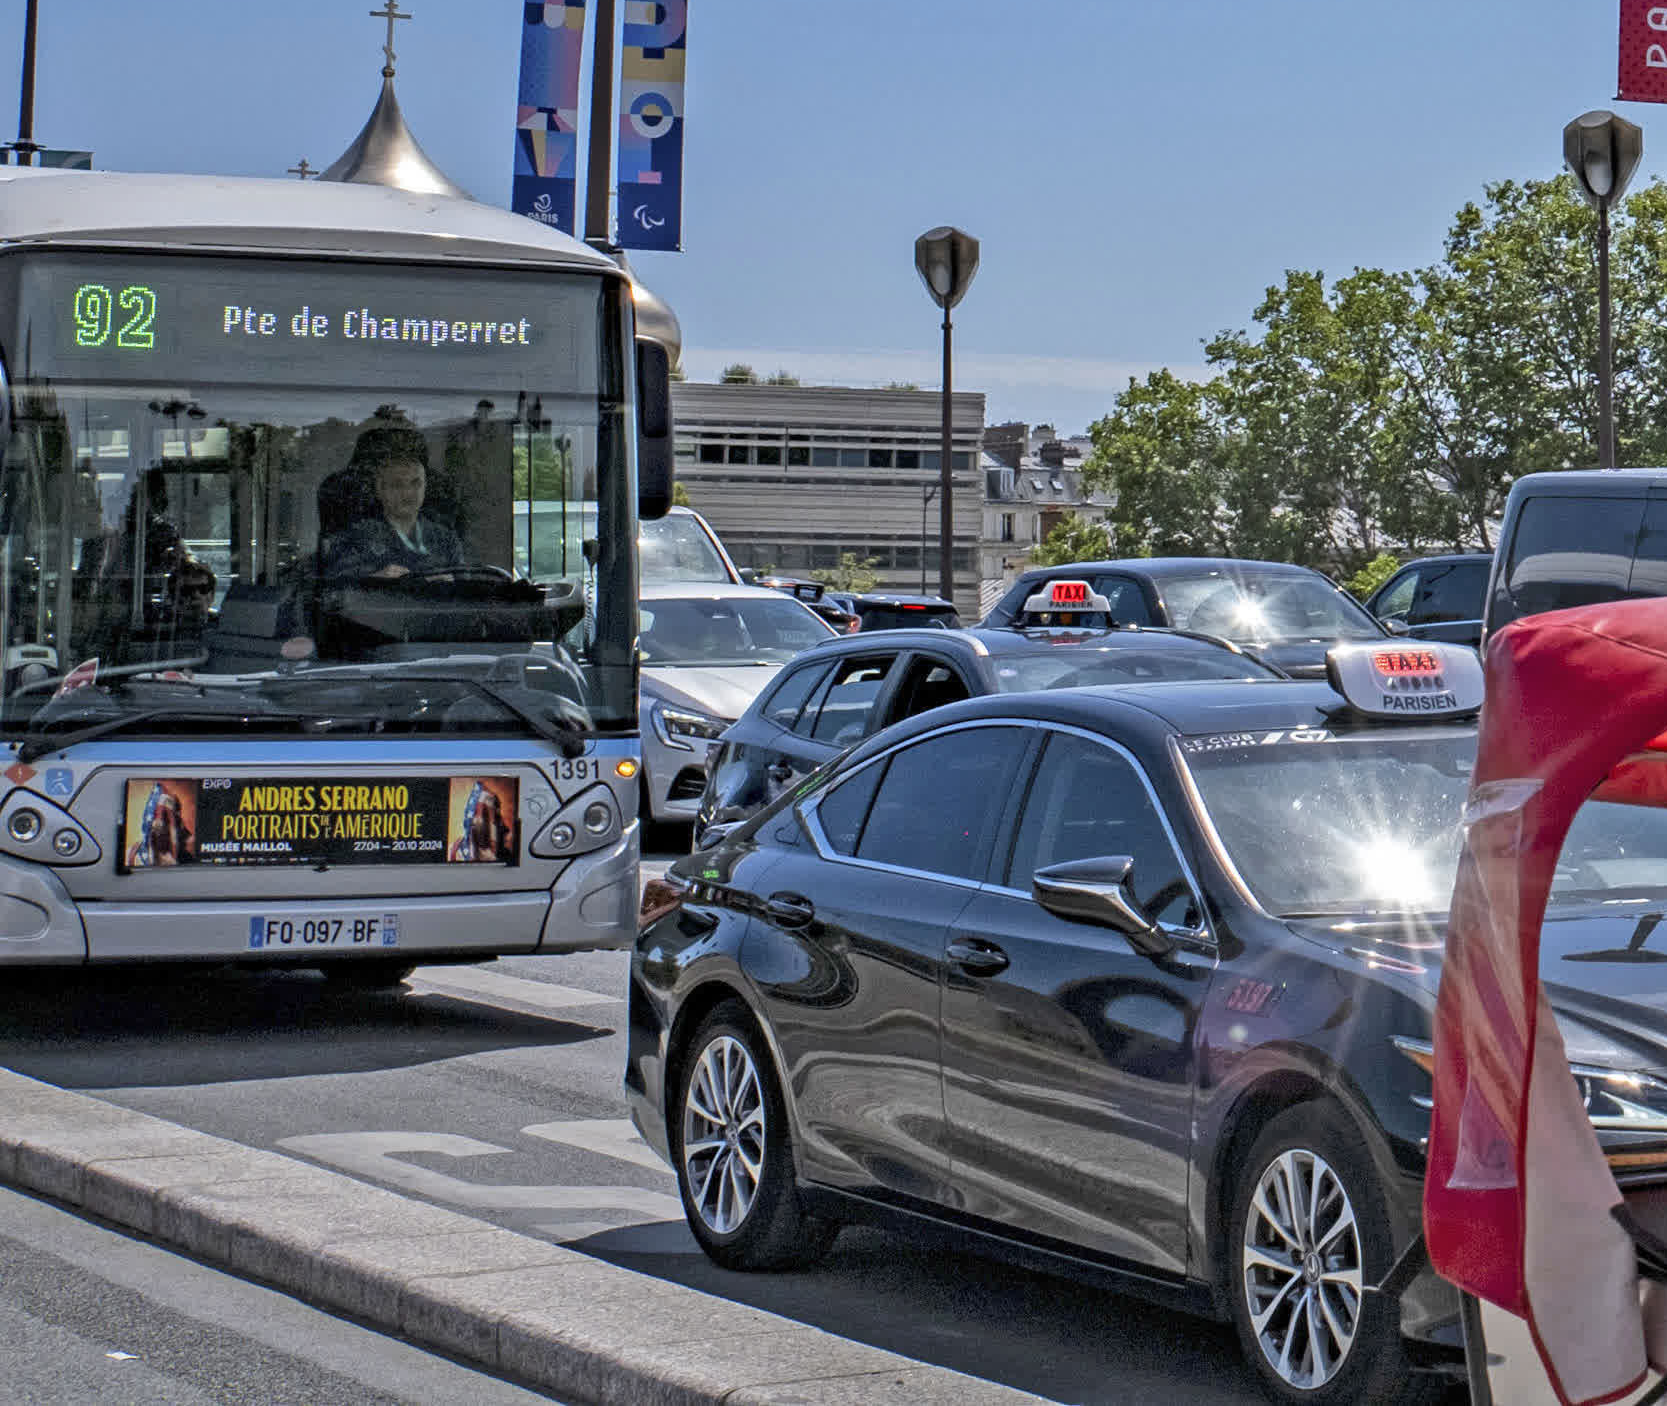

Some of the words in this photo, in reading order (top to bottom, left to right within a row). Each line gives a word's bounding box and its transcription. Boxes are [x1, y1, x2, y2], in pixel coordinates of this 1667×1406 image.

[527, 212, 558, 224] PARIS
[74, 284, 157, 349] 92
[223, 305, 277, 337] Pte
[291, 305, 329, 338] de
[343, 307, 535, 347] Champerret
[1055, 585, 1086, 600] TAXI
[1388, 655, 1438, 672] TAXI
[1383, 694, 1457, 711] PARISIEN
[1209, 732, 1255, 744] CLUB
[549, 759, 600, 780] 1391
[202, 778, 232, 790] EXPO
[240, 785, 316, 812] ANDRES
[320, 785, 409, 811] SERRANO
[222, 814, 320, 840] PORTRAITS
[333, 813, 424, 840] AMÉRIQUE
[201, 841, 241, 853] MUSÉE
[243, 841, 293, 852] MAILLOL
[392, 841, 417, 851] 20.10
[419, 840, 443, 850] 2024
